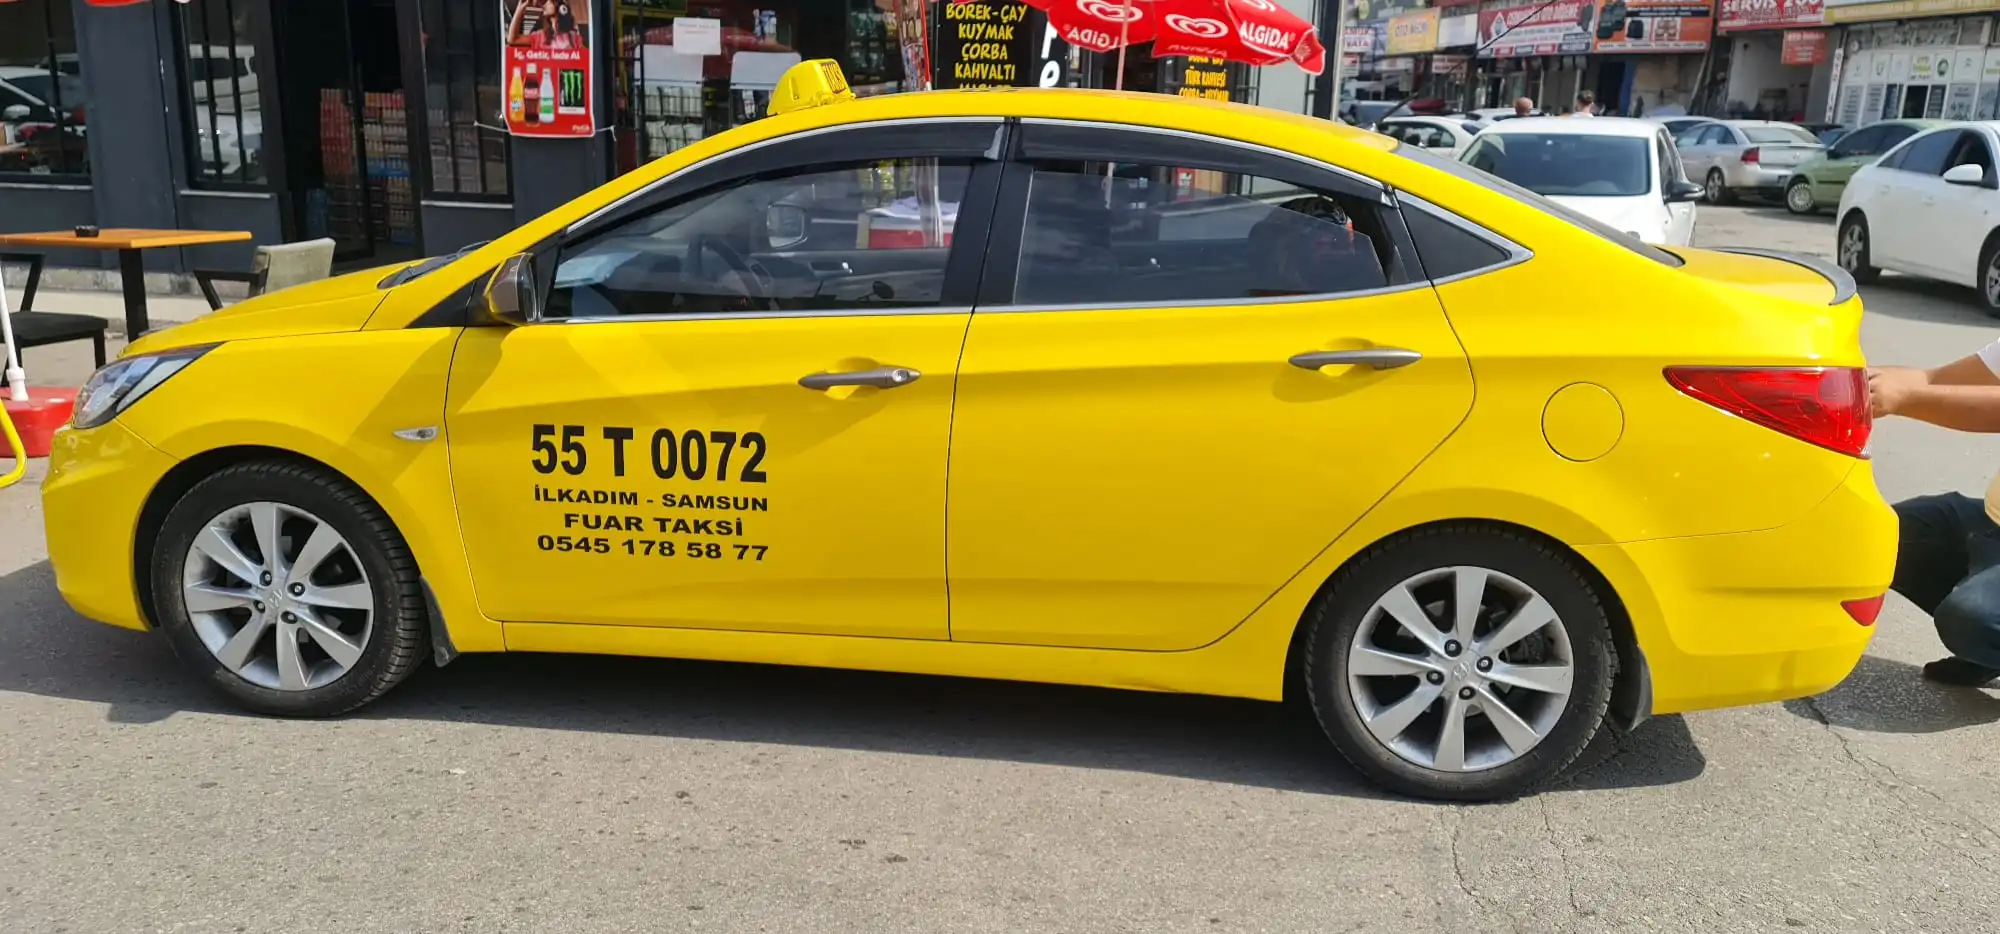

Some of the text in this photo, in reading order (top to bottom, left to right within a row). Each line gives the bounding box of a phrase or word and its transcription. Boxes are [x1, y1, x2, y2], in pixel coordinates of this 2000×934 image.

[958, 23, 1014, 40] KUYMAK
[961, 43, 1008, 61] ÇORBA
[955, 62, 1016, 81] KAHVALTI
[532, 424, 767, 483] 55 T 0072
[534, 484, 638, 506] İLKADIM
[662, 493, 768, 512] SAMSUN
[564, 513, 743, 536] FUAR TAKSİ
[537, 535, 769, 561] 0545 178 58 77
